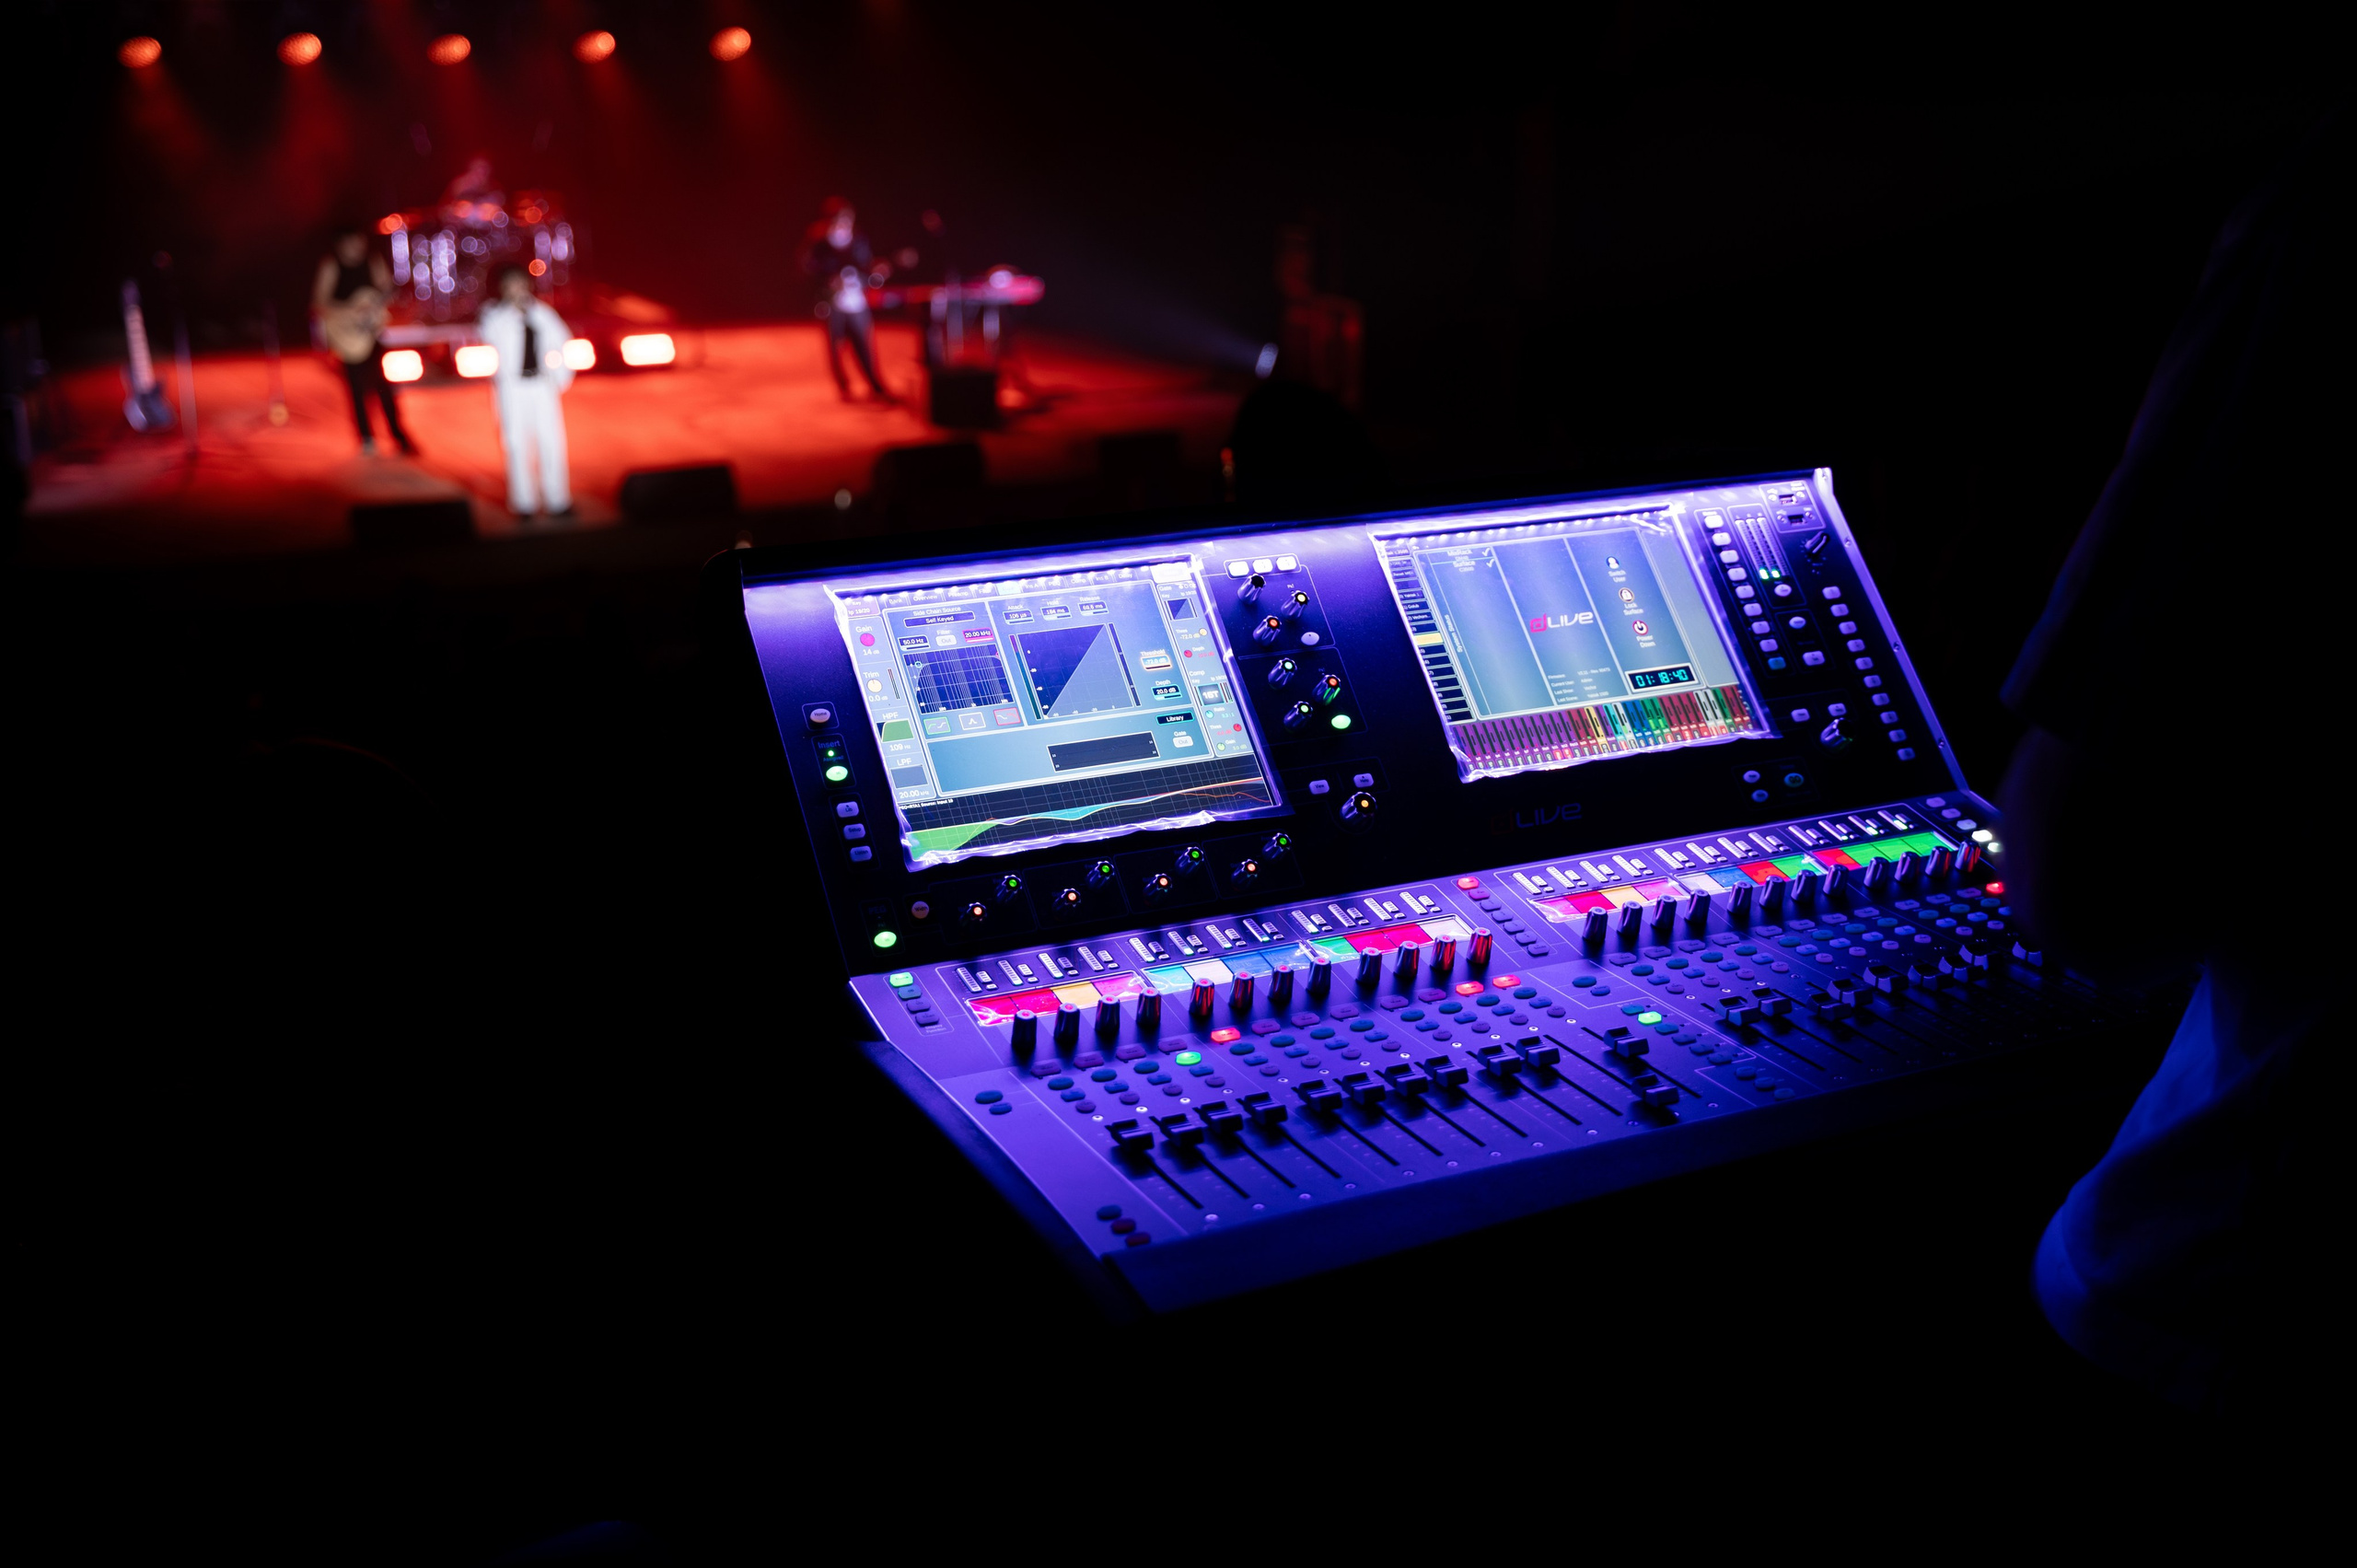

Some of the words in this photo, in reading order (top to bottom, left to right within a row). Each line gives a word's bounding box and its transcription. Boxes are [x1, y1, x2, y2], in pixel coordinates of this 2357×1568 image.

[1636, 669, 1689, 687] 01:18:40
[882, 712, 899, 720] HPF
[818, 740, 841, 749] Insert
[897, 758, 911, 766] LPF
[899, 790, 919, 799] 20.00
